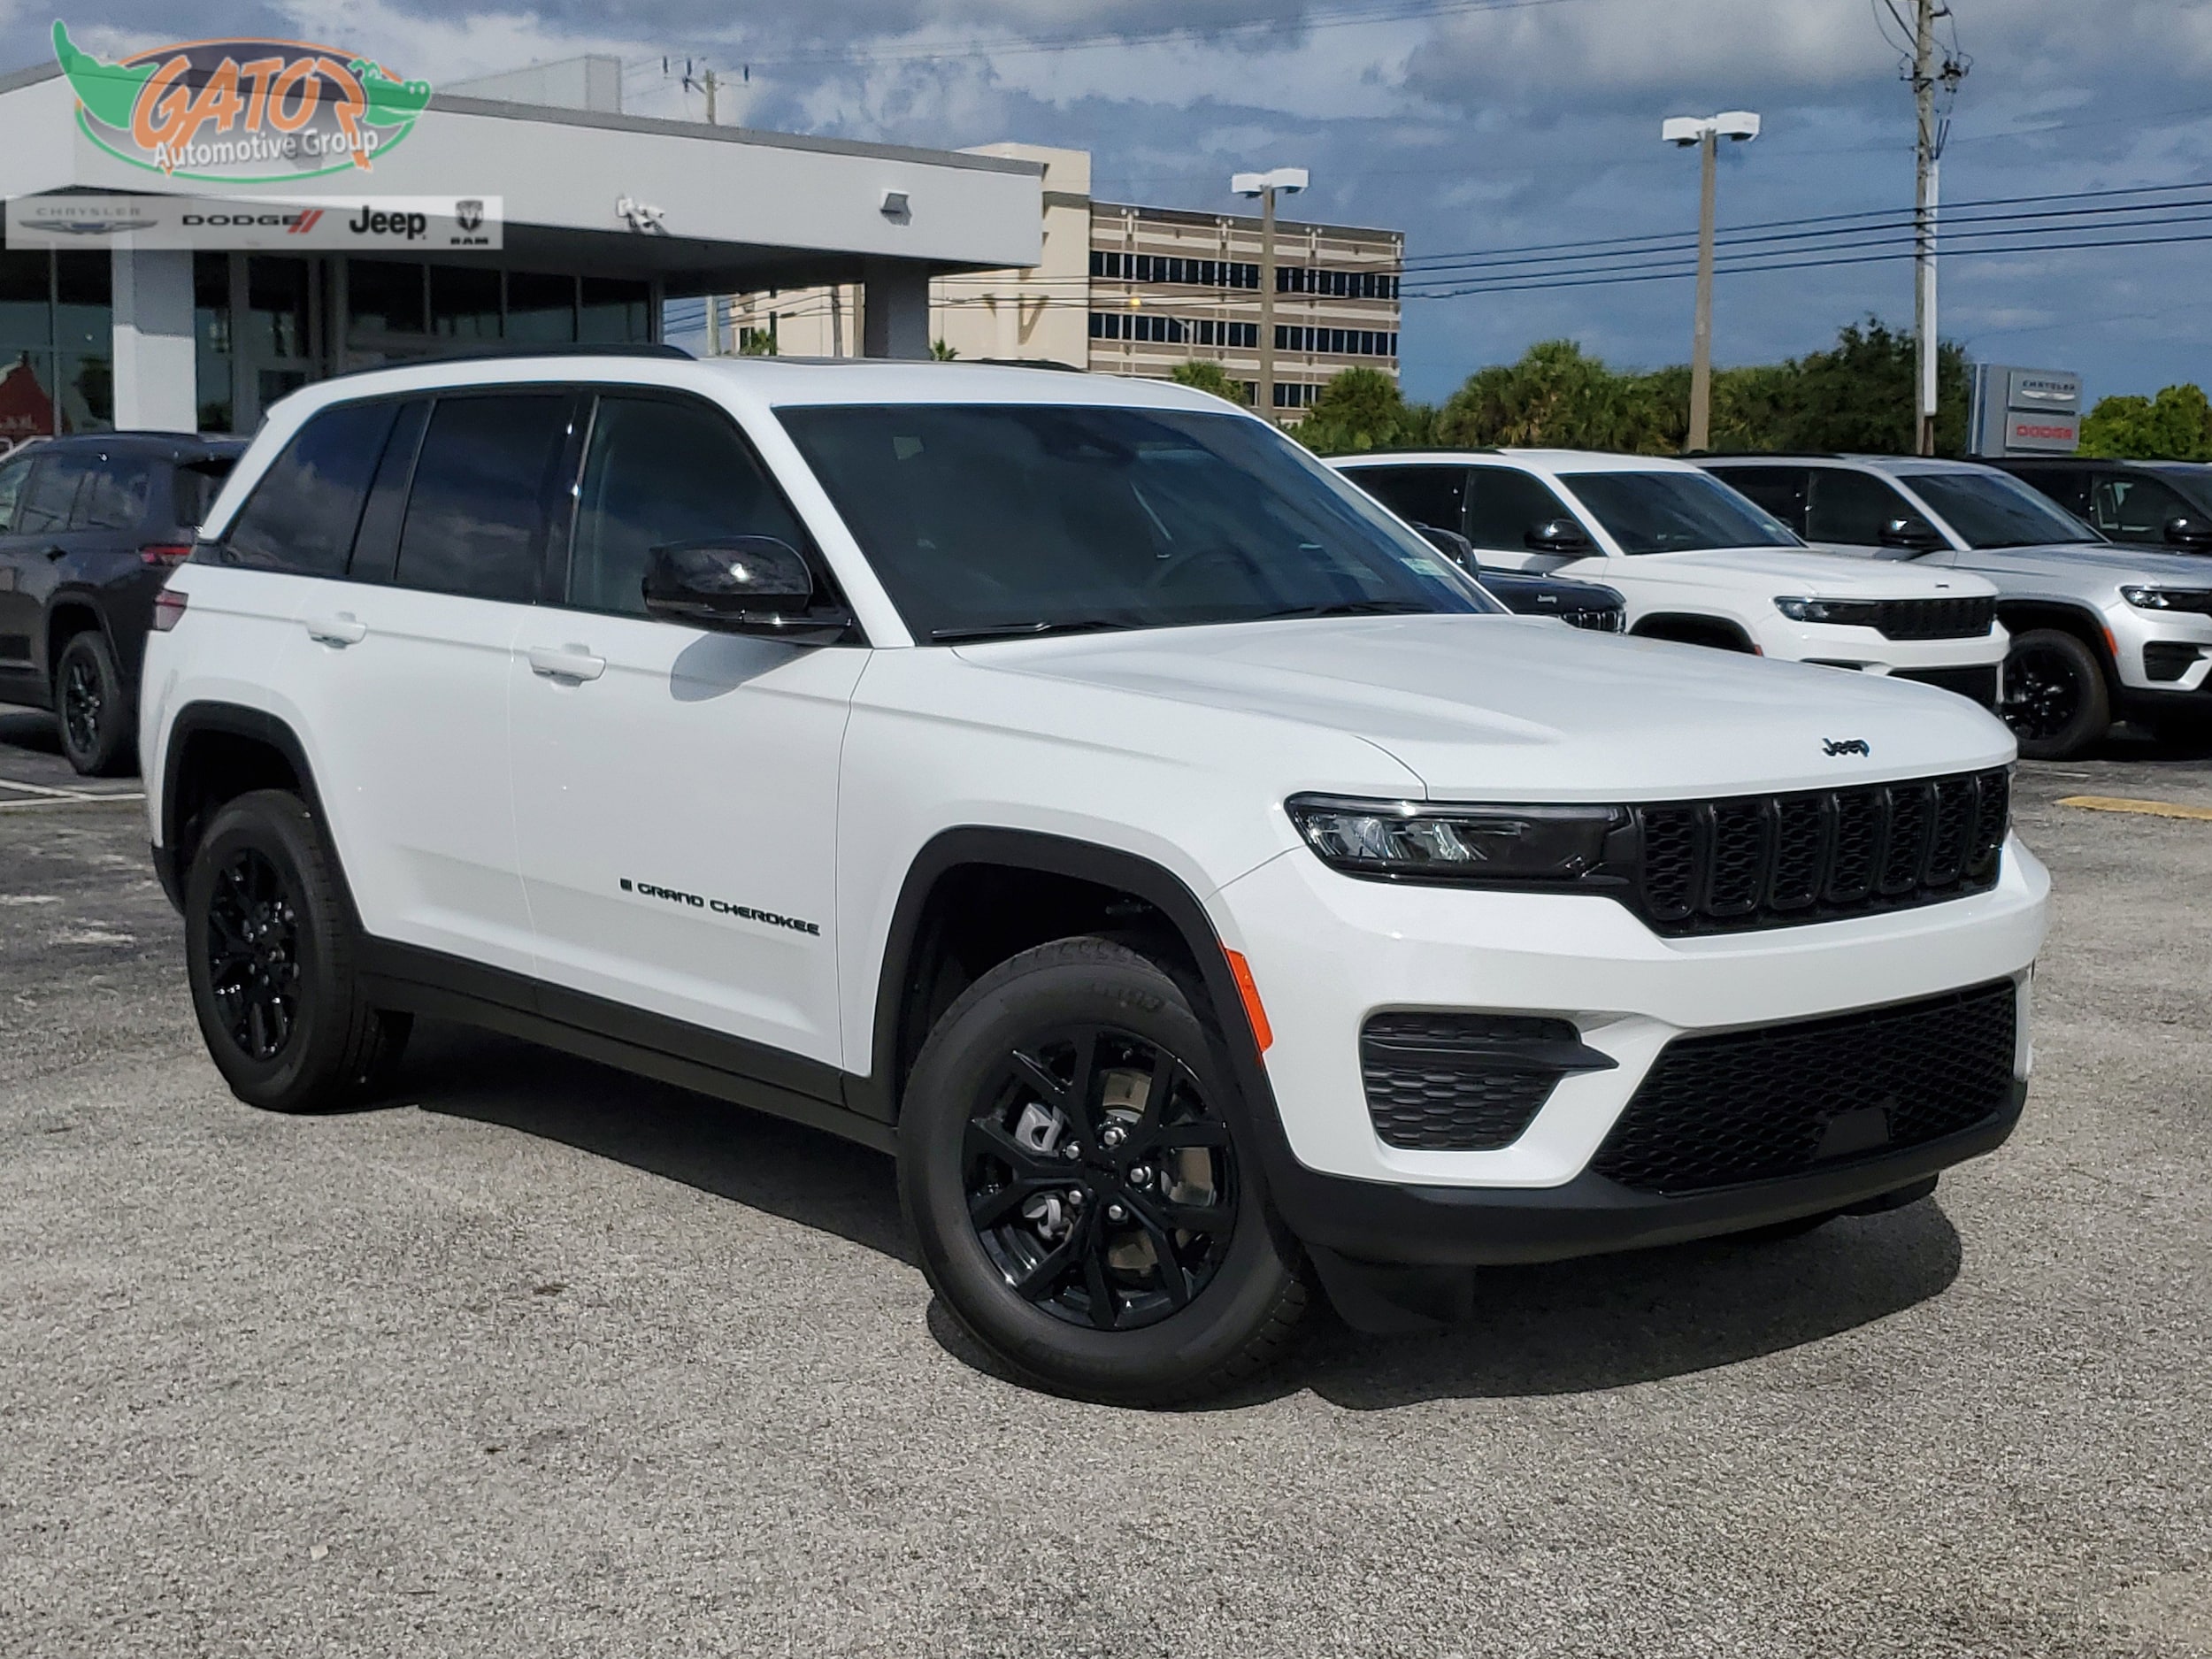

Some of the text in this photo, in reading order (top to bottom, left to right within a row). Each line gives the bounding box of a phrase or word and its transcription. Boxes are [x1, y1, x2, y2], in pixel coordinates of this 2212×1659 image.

[2023, 380, 2075, 391] CHRYSLER
[1822, 737, 1870, 757] Jeep
[637, 882, 821, 937] GRAND CHEROKEE
